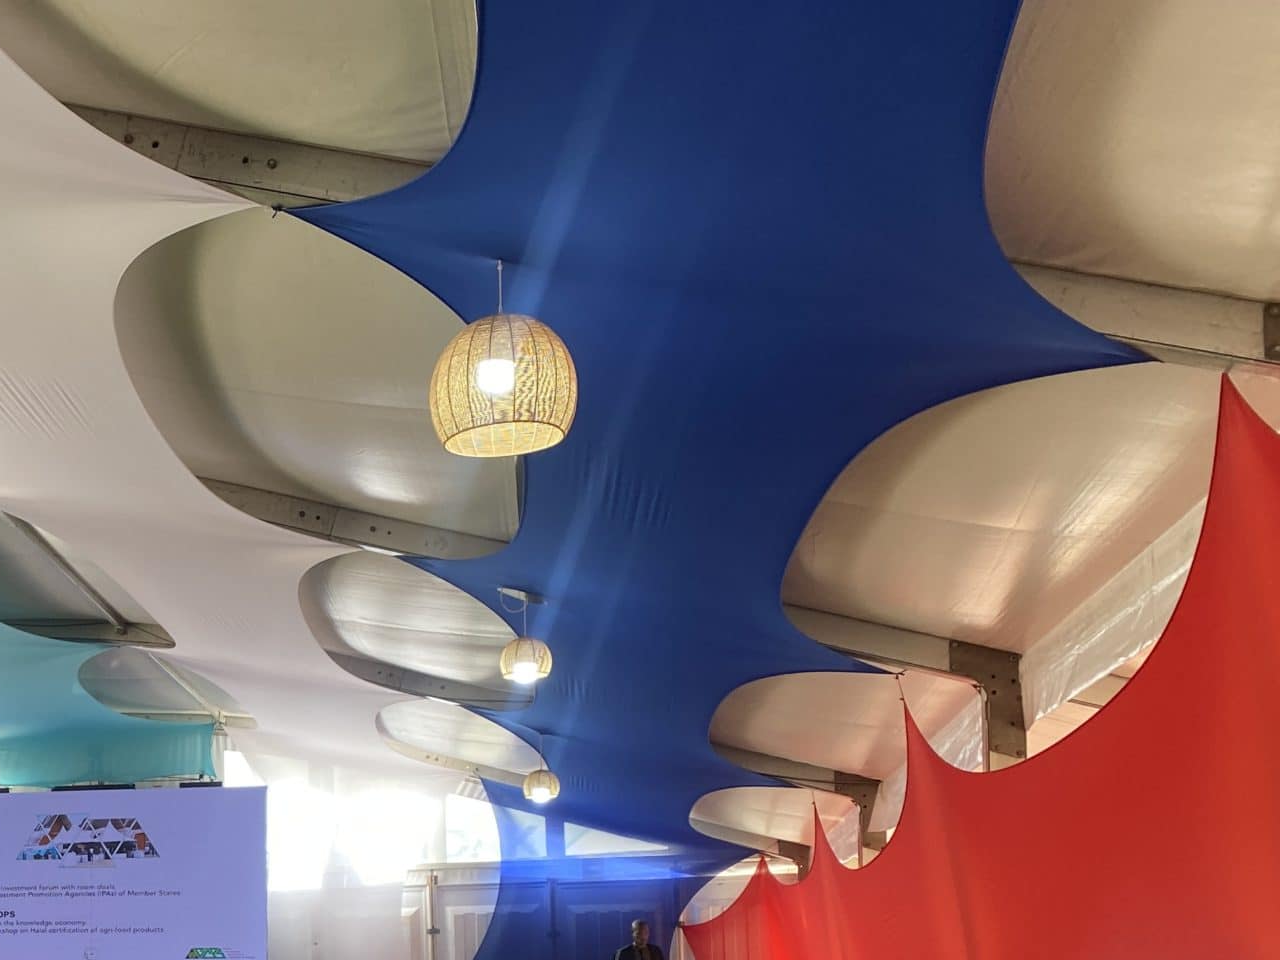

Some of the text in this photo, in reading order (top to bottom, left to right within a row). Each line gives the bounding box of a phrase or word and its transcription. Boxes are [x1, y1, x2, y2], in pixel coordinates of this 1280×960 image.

[65, 890, 96, 898] Agencies
[127, 889, 157, 897] Member
[158, 889, 181, 897] States
[16, 919, 53, 927] knowledge
[132, 926, 164, 935] products
